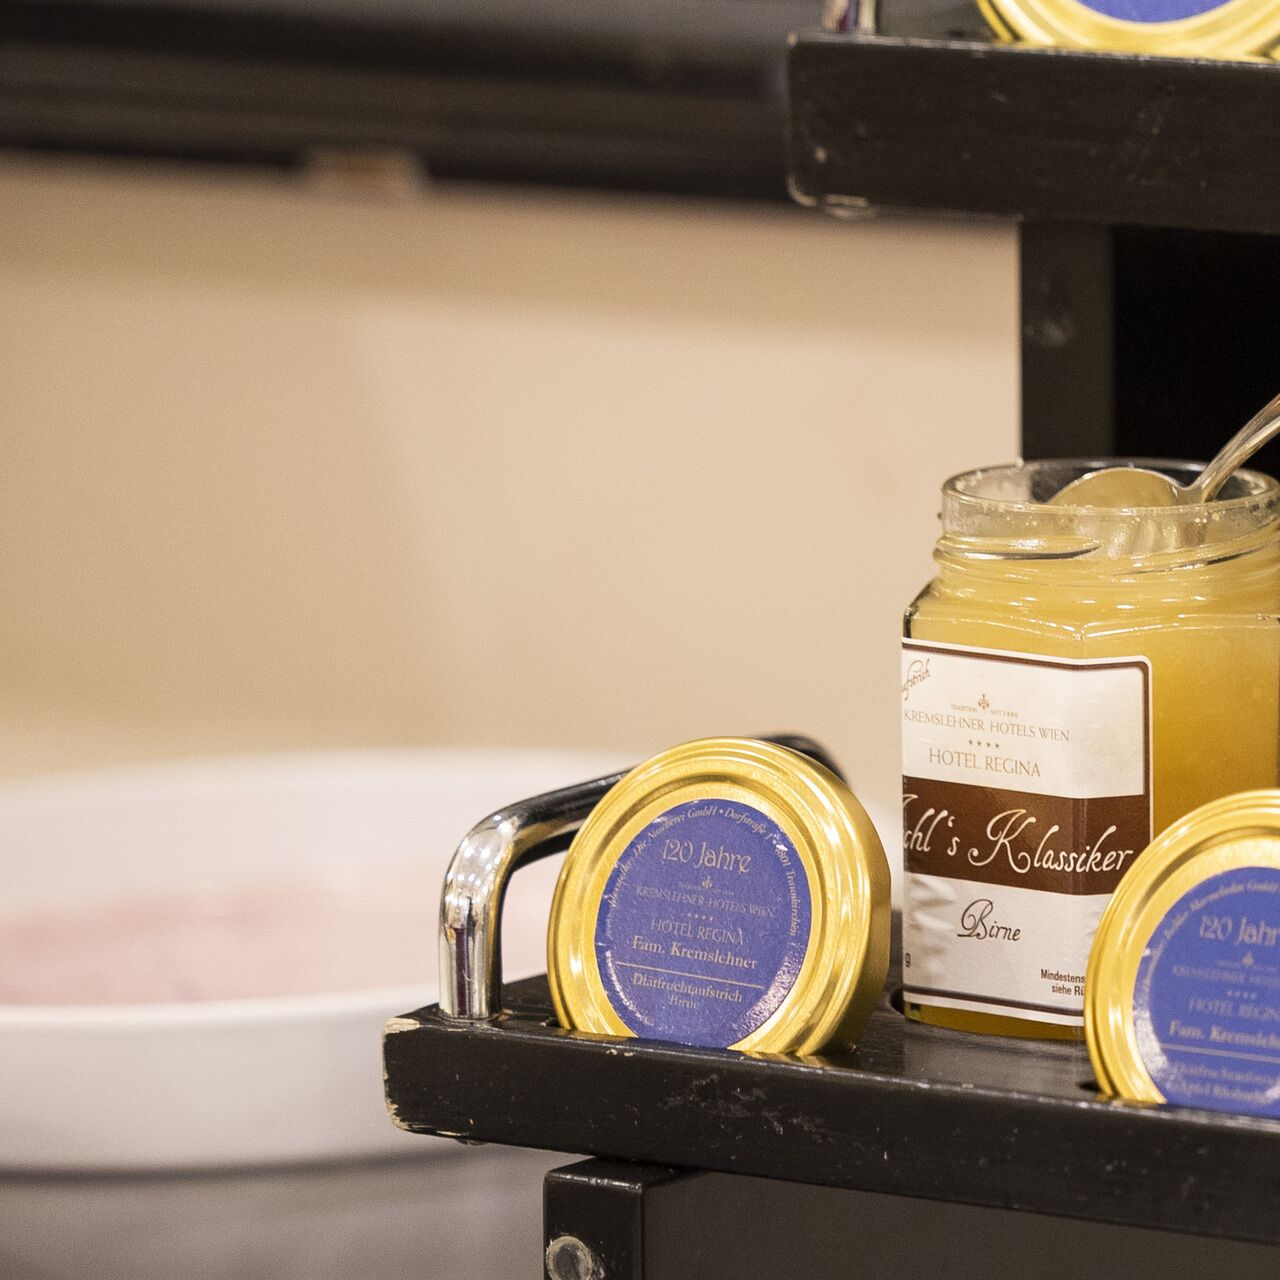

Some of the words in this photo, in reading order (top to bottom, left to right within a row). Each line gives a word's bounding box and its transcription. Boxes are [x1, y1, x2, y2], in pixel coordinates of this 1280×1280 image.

[904, 709, 985, 732] KREMSLEHNER
[990, 722, 1036, 738] HOTELS
[1038, 727, 1071, 742] WIEN
[929, 748, 981, 769] HOTEL
[985, 758, 1041, 777] REGINA
[662, 839, 693, 863] 120
[695, 842, 753, 873] Jahre
[968, 808, 1135, 875] Klassiker
[651, 917, 693, 938] HOTEL
[698, 926, 745, 946] REGINA
[957, 899, 1022, 943] Birne
[1199, 915, 1233, 940] 120
[632, 935, 665, 954] Fam.
[671, 941, 758, 969] Kremslehner
[669, 994, 700, 1009] Birne
[1051, 985, 1072, 995] siehe
